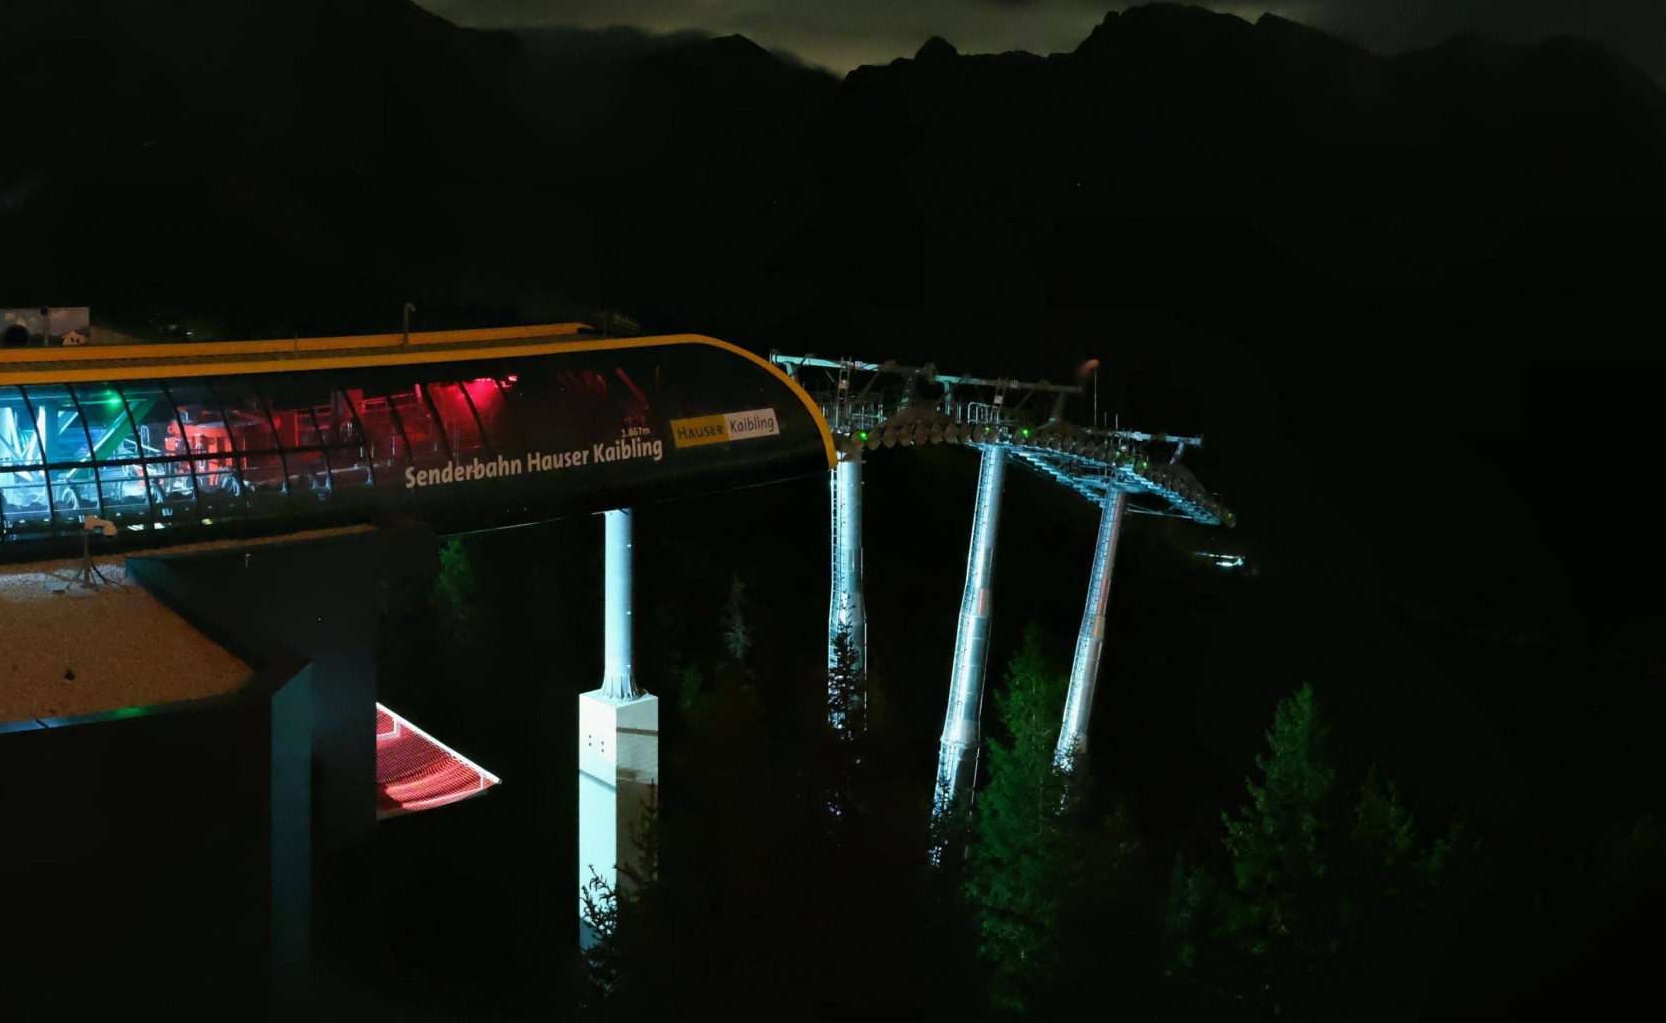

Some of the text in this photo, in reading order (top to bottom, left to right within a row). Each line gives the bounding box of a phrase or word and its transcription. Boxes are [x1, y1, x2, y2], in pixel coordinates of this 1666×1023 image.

[677, 415, 774, 440] HAUSER Kaibling
[405, 437, 663, 489] Senderbahn Hauser Kaibling
